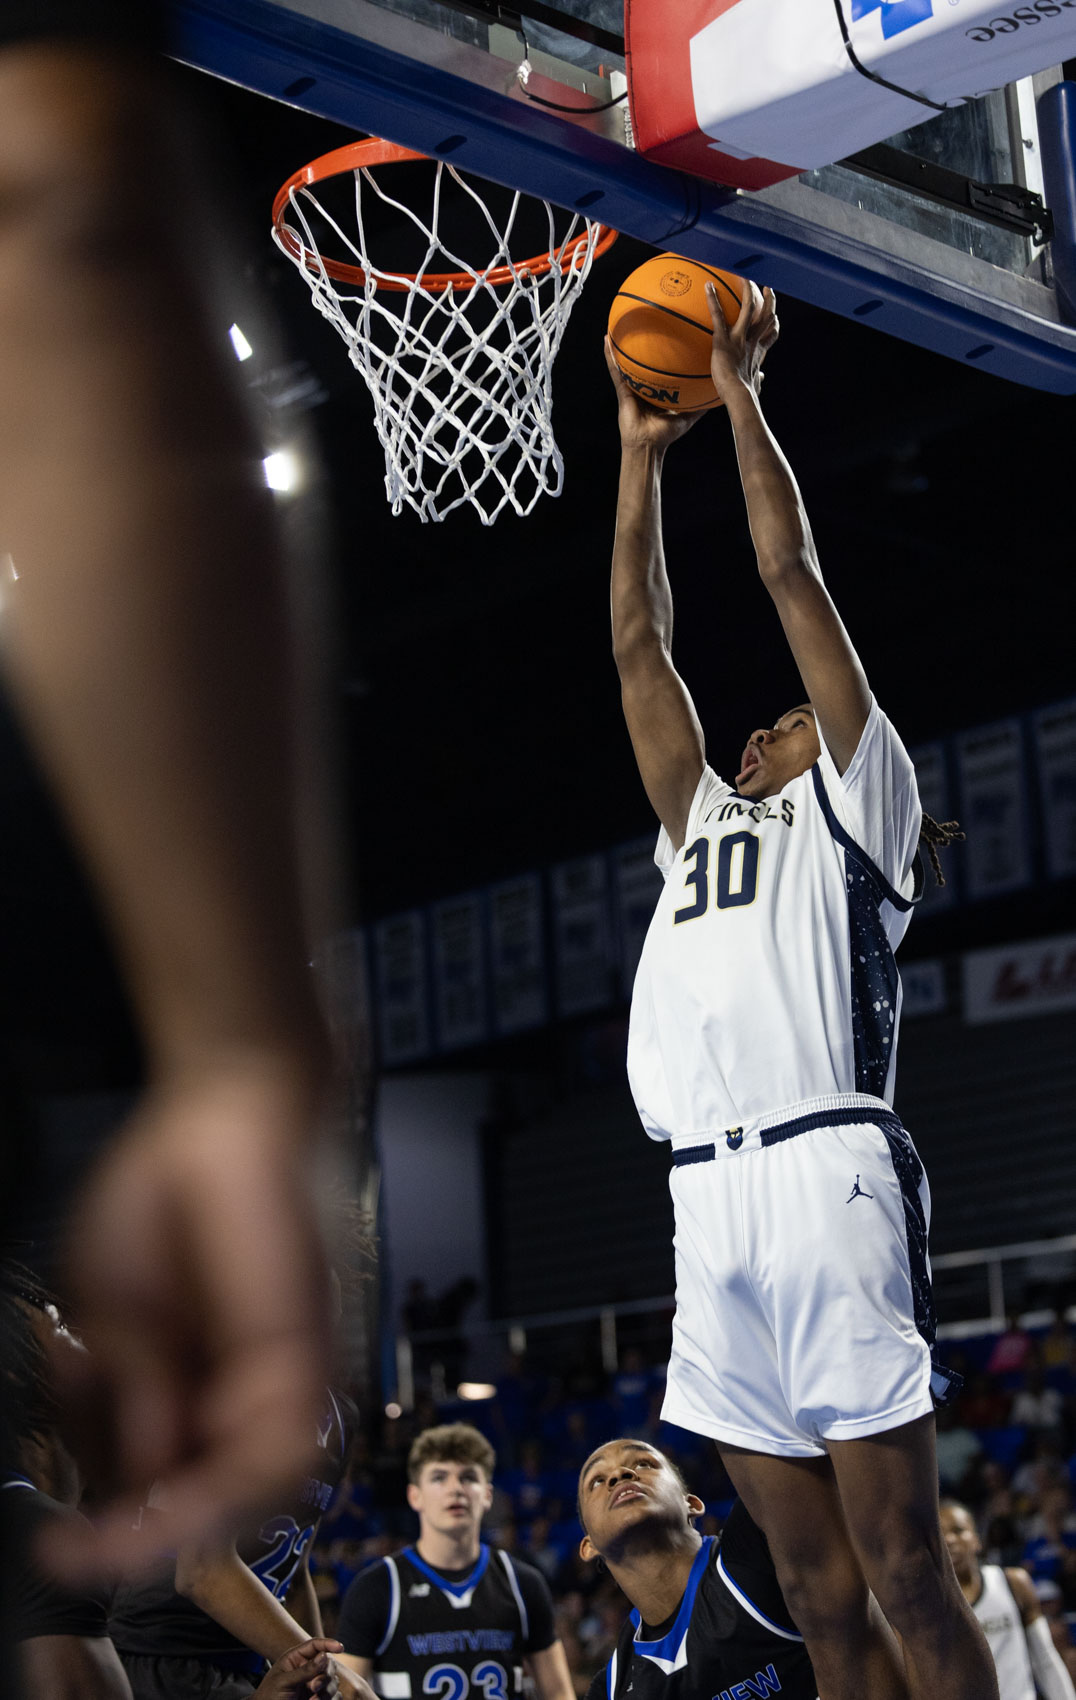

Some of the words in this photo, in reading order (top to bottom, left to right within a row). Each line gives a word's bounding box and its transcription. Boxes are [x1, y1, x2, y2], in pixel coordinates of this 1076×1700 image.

[672, 830, 761, 927] 30
[406, 1629, 516, 1656] WESTVIEW
[423, 1660, 509, 1700] 23
